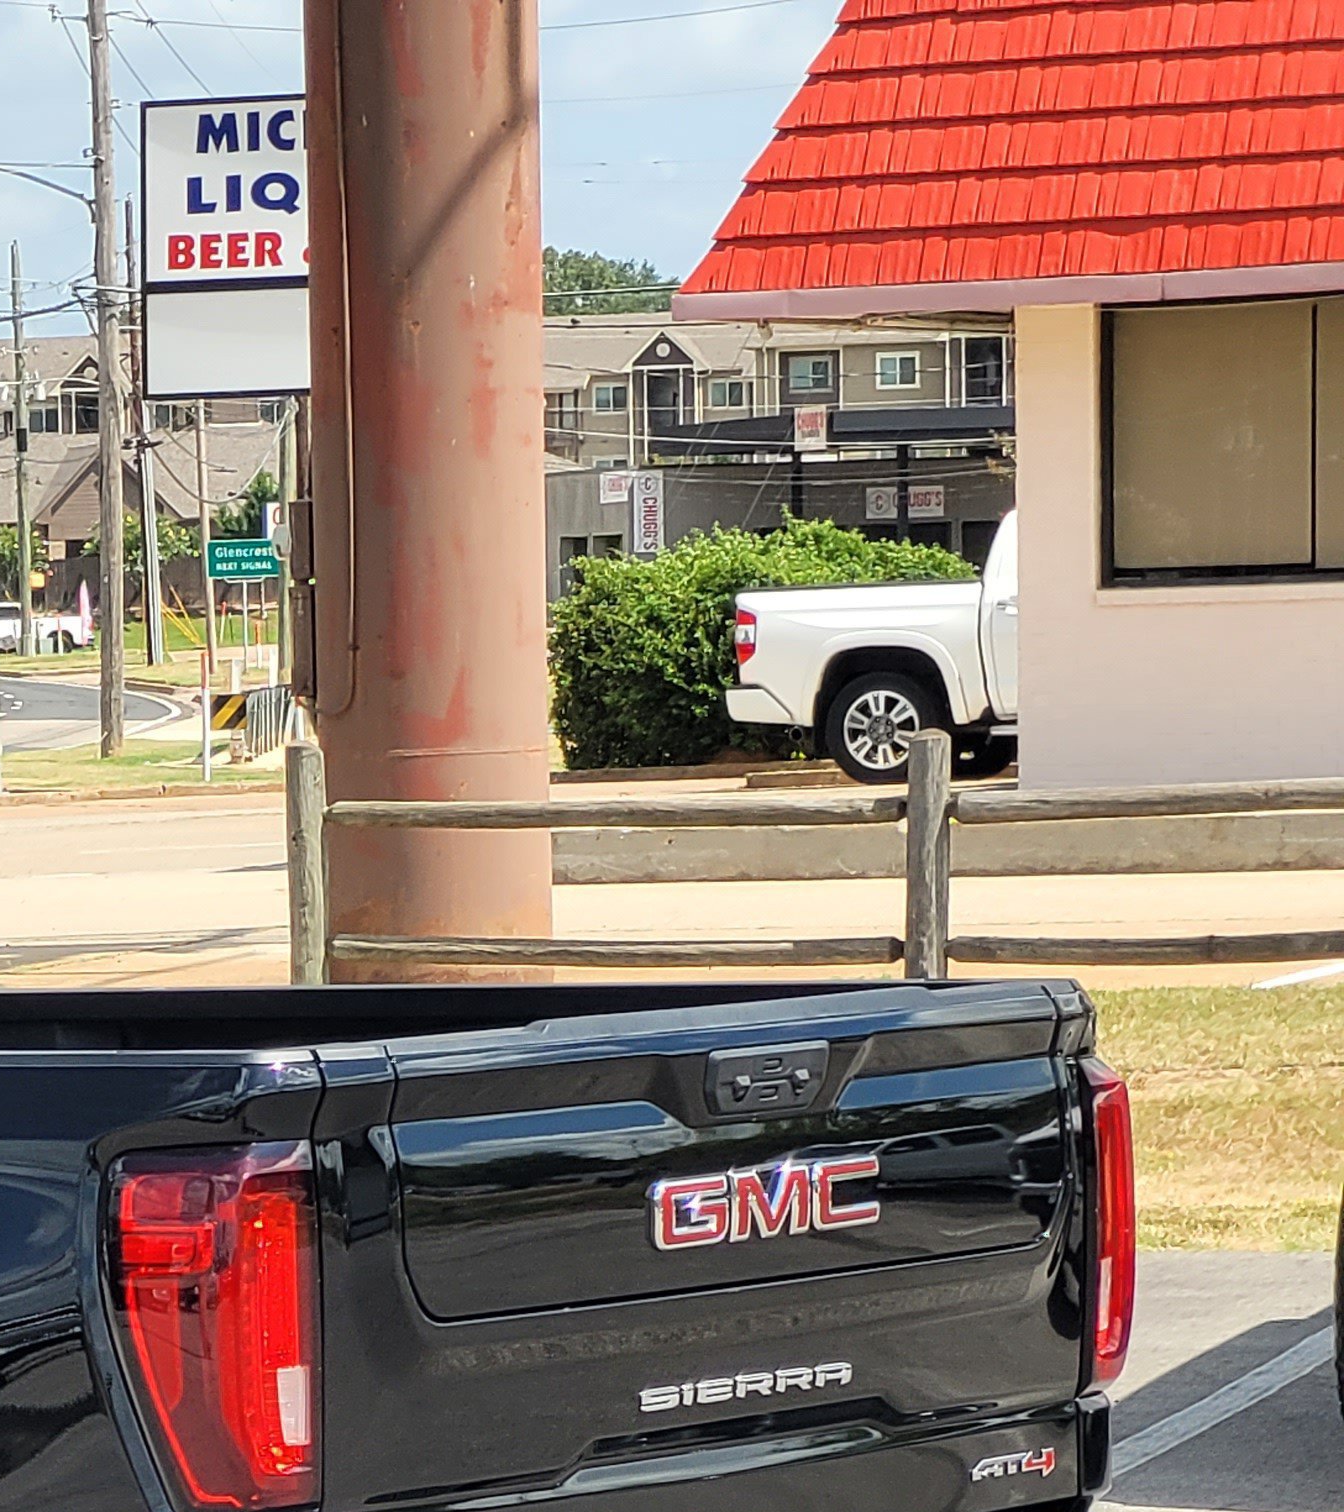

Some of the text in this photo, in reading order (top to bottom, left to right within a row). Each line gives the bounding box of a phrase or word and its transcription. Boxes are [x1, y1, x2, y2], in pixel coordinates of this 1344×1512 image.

[196, 109, 308, 153] MIC
[167, 231, 283, 270] BEER
[641, 497, 659, 551] CHUGG'S
[215, 547, 273, 558] Glencrest
[215, 561, 273, 571] NEXT SIGNAL
[650, 1154, 881, 1251] GMC
[639, 1361, 853, 1412] SIERRA
[972, 1448, 1056, 1481] AT4
